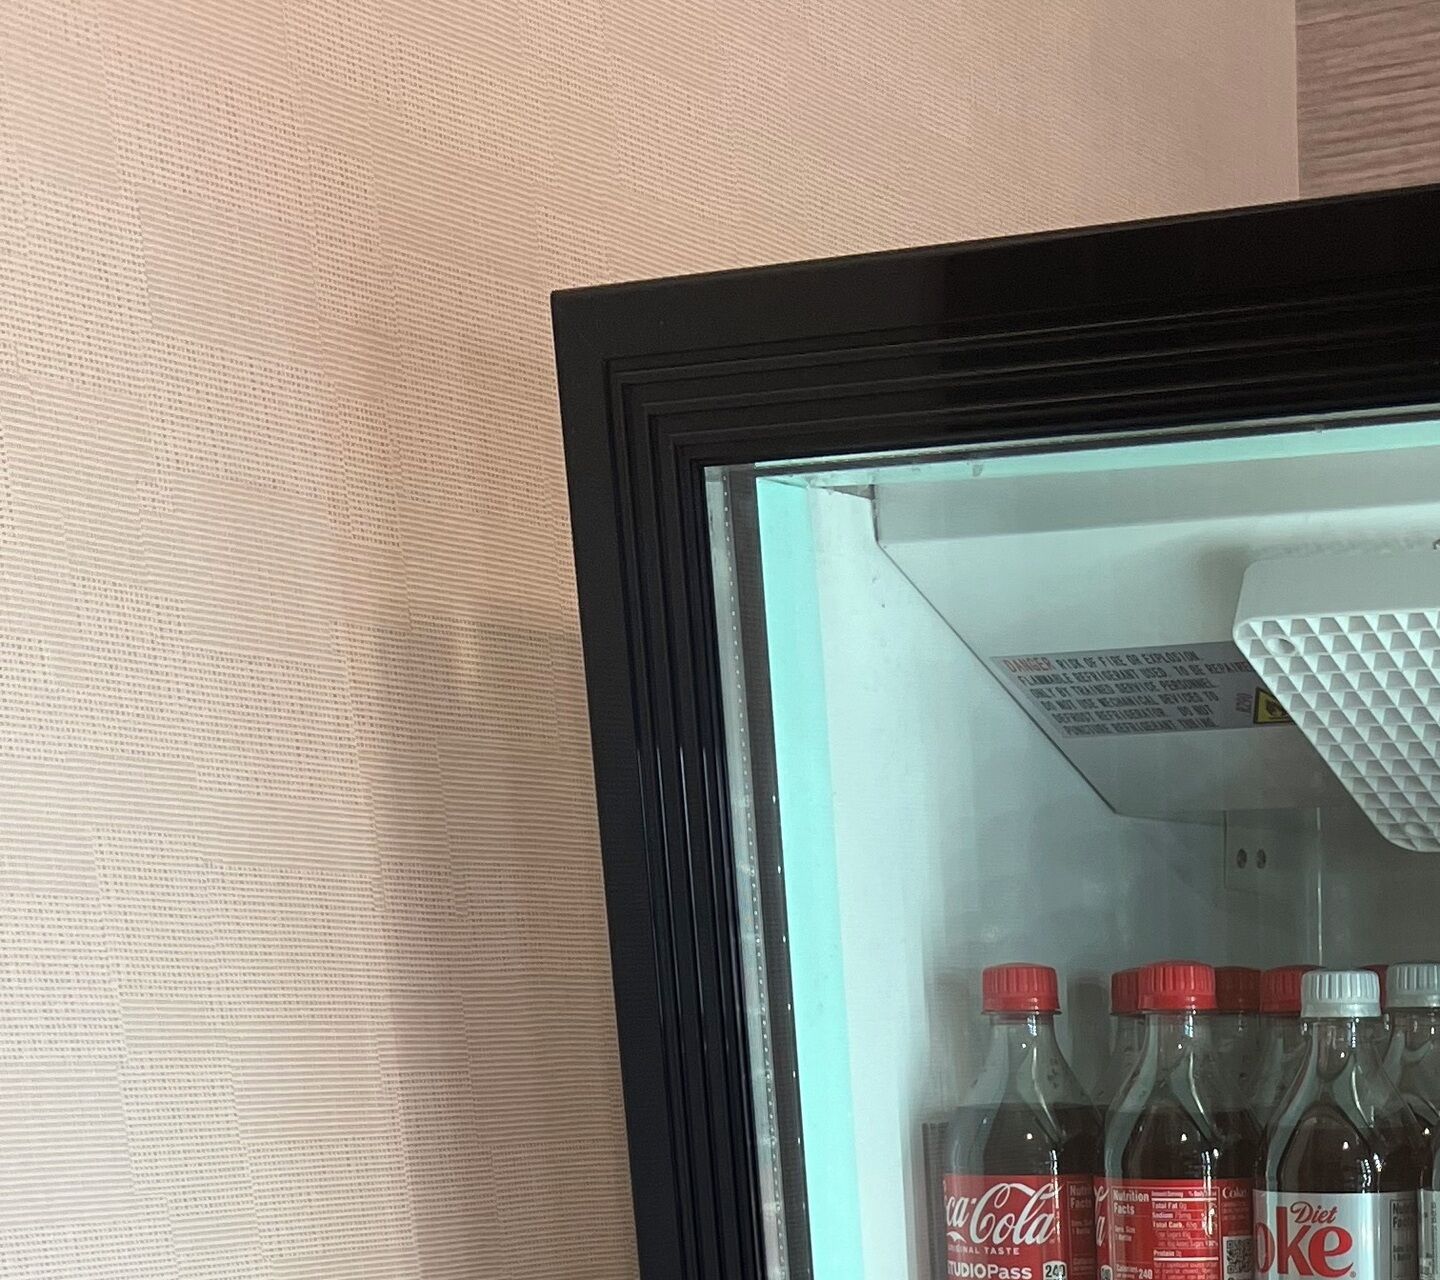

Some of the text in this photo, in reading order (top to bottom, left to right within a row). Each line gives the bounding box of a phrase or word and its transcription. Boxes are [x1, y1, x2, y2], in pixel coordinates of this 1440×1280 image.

[1004, 657, 1054, 672] DANGER
[1056, 658, 1079, 670] RISK
[1084, 657, 1099, 668] OF
[1113, 1190, 1149, 1202] Nutrition
[1113, 1203, 1135, 1215] Facts
[1290, 1201, 1337, 1224] Diet
[1255, 1206, 1354, 1278] oke
[984, 1247, 1020, 1255] TASTE
[947, 1260, 1032, 1280] TUDIOPass
[1138, 1269, 1153, 1280] 240
